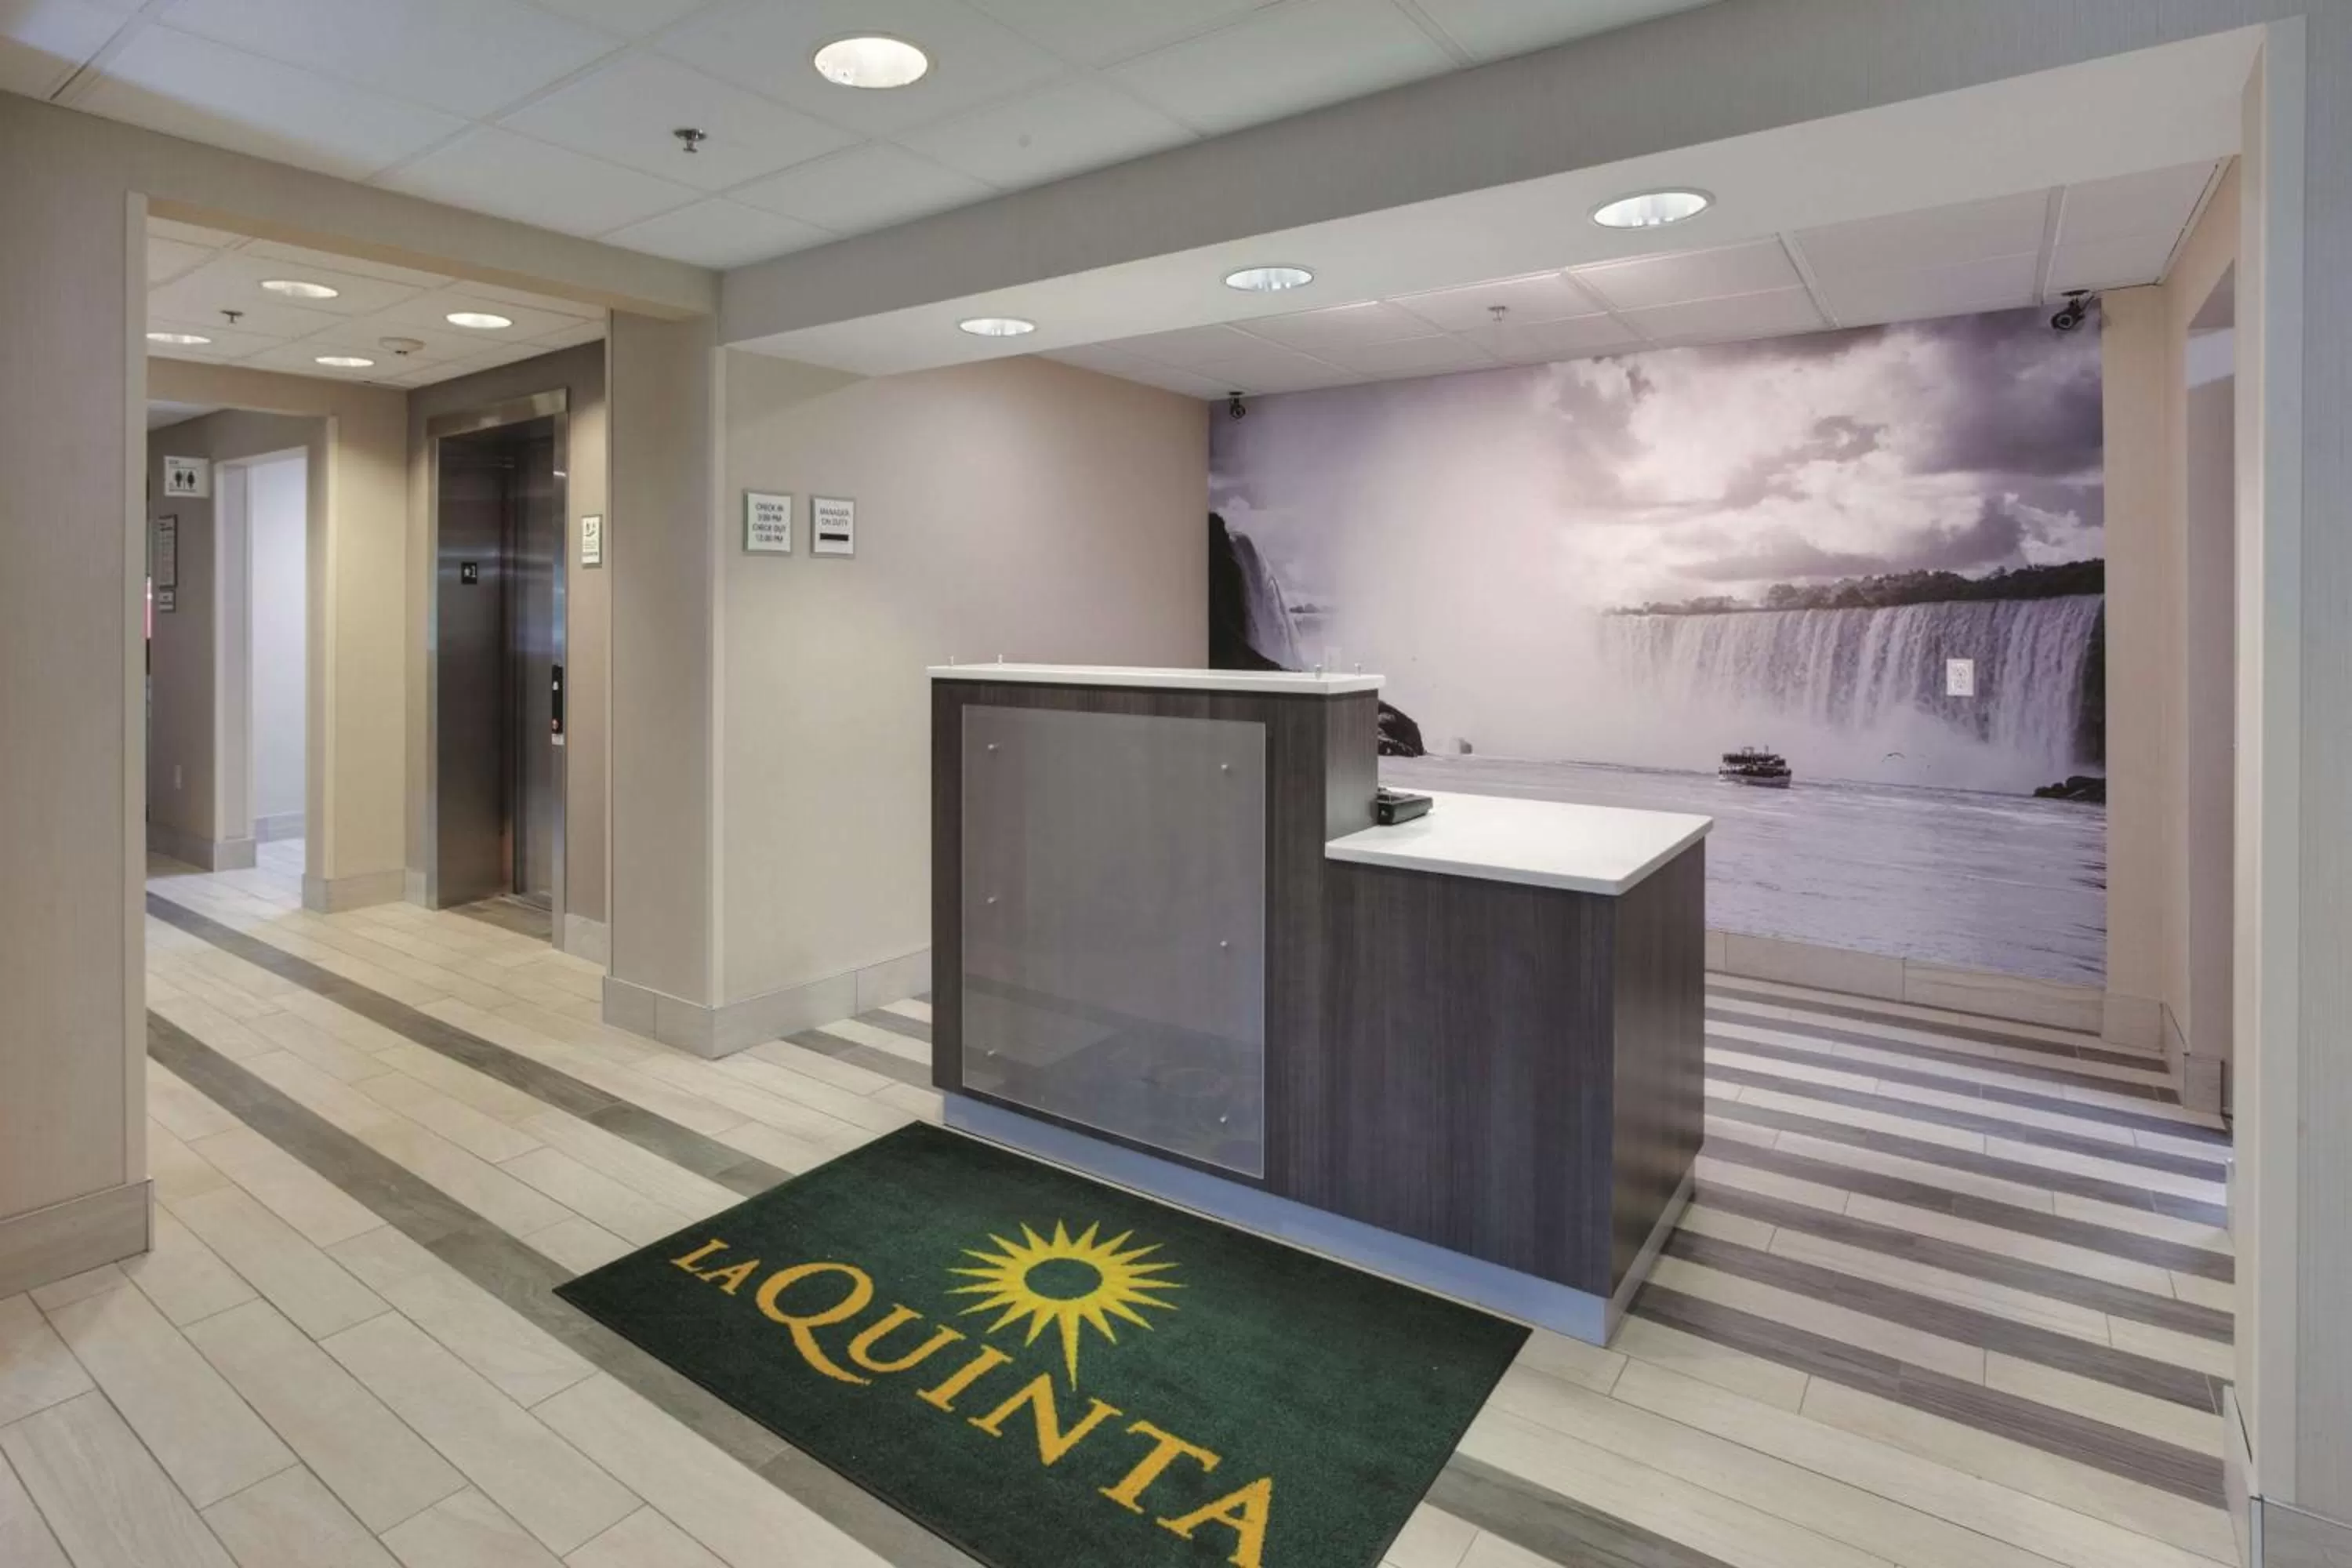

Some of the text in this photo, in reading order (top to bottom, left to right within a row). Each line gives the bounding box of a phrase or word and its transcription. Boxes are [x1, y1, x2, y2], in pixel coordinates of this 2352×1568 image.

[755, 503, 775, 512] CHECK
[819, 507, 849, 517] MANAGER
[832, 518, 848, 527] DUTY
[753, 523, 786, 533] CHECK OUT
[670, 1239, 1273, 1568] LA QUINTA
